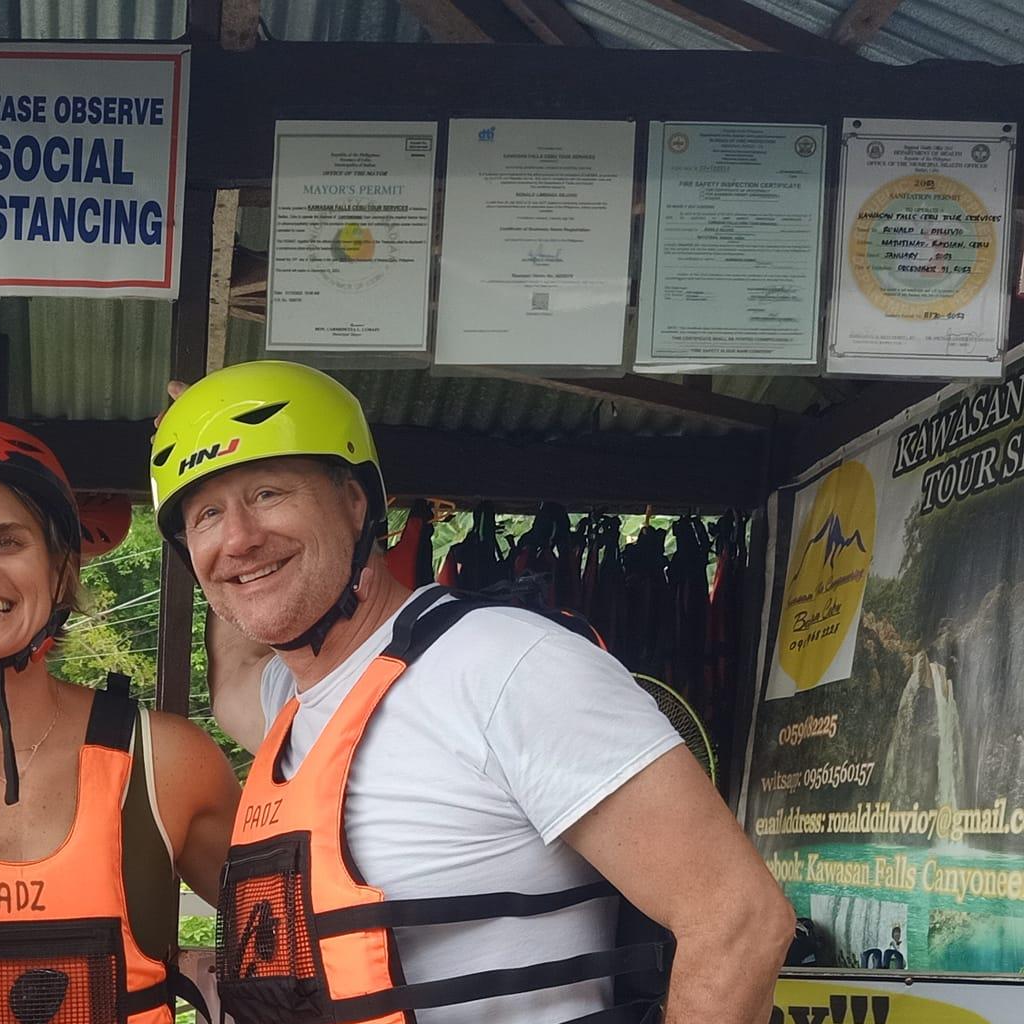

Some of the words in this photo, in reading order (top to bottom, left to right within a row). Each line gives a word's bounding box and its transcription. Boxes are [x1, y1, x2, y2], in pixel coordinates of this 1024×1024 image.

[54, 96, 165, 126] OBSERVE
[303, 184, 356, 196] MAYOR'S
[359, 184, 405, 196] PERMIT
[894, 372, 1024, 474] KAWASAN
[921, 446, 998, 511] TOUR
[242, 799, 283, 833] PADZ
[807, 853, 870, 886] Kawasan
[874, 854, 916, 890] Falls
[922, 859, 1024, 905] Canyonee
